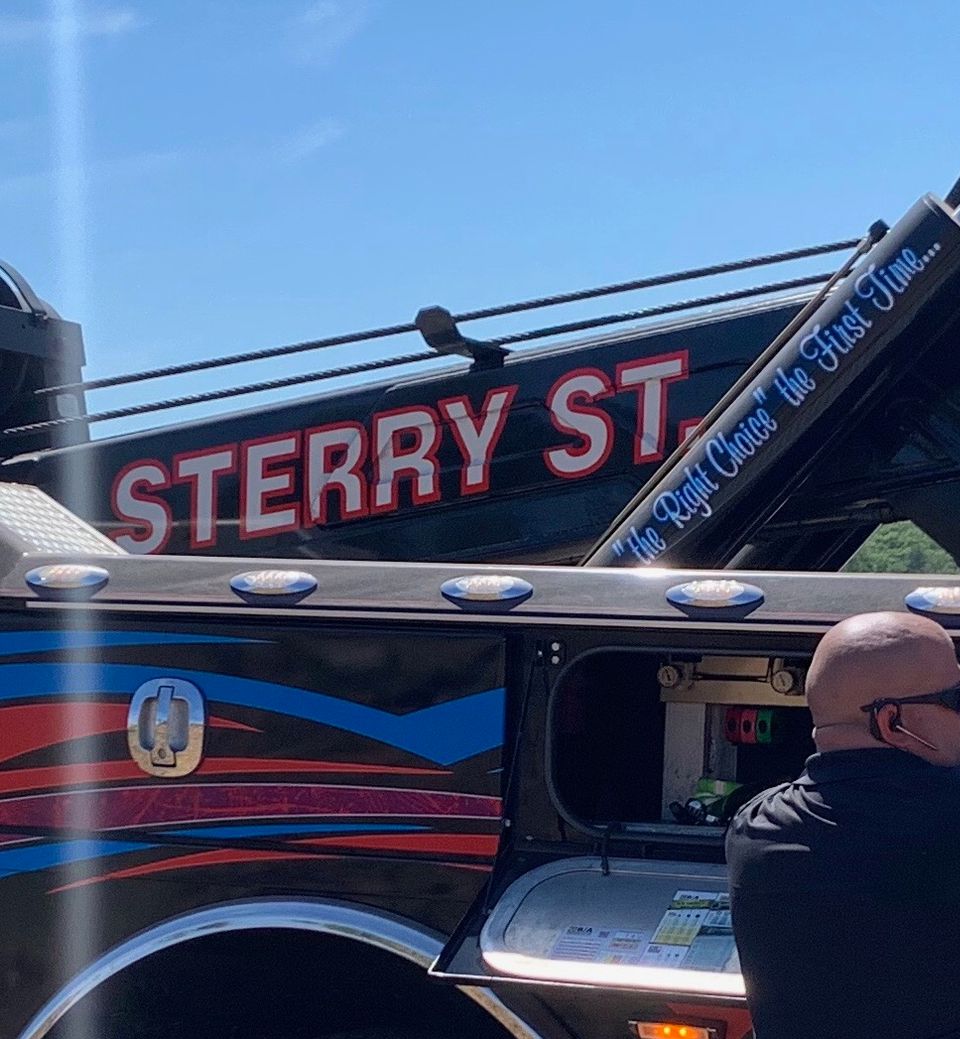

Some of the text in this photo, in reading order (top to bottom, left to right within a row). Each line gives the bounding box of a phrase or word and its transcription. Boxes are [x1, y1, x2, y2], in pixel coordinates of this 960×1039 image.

[113, 385, 518, 554] STERRY
[653, 463, 720, 529] Right
[706, 386, 778, 478] Choice"
[775, 367, 816, 406] the
[799, 300, 873, 372] First
